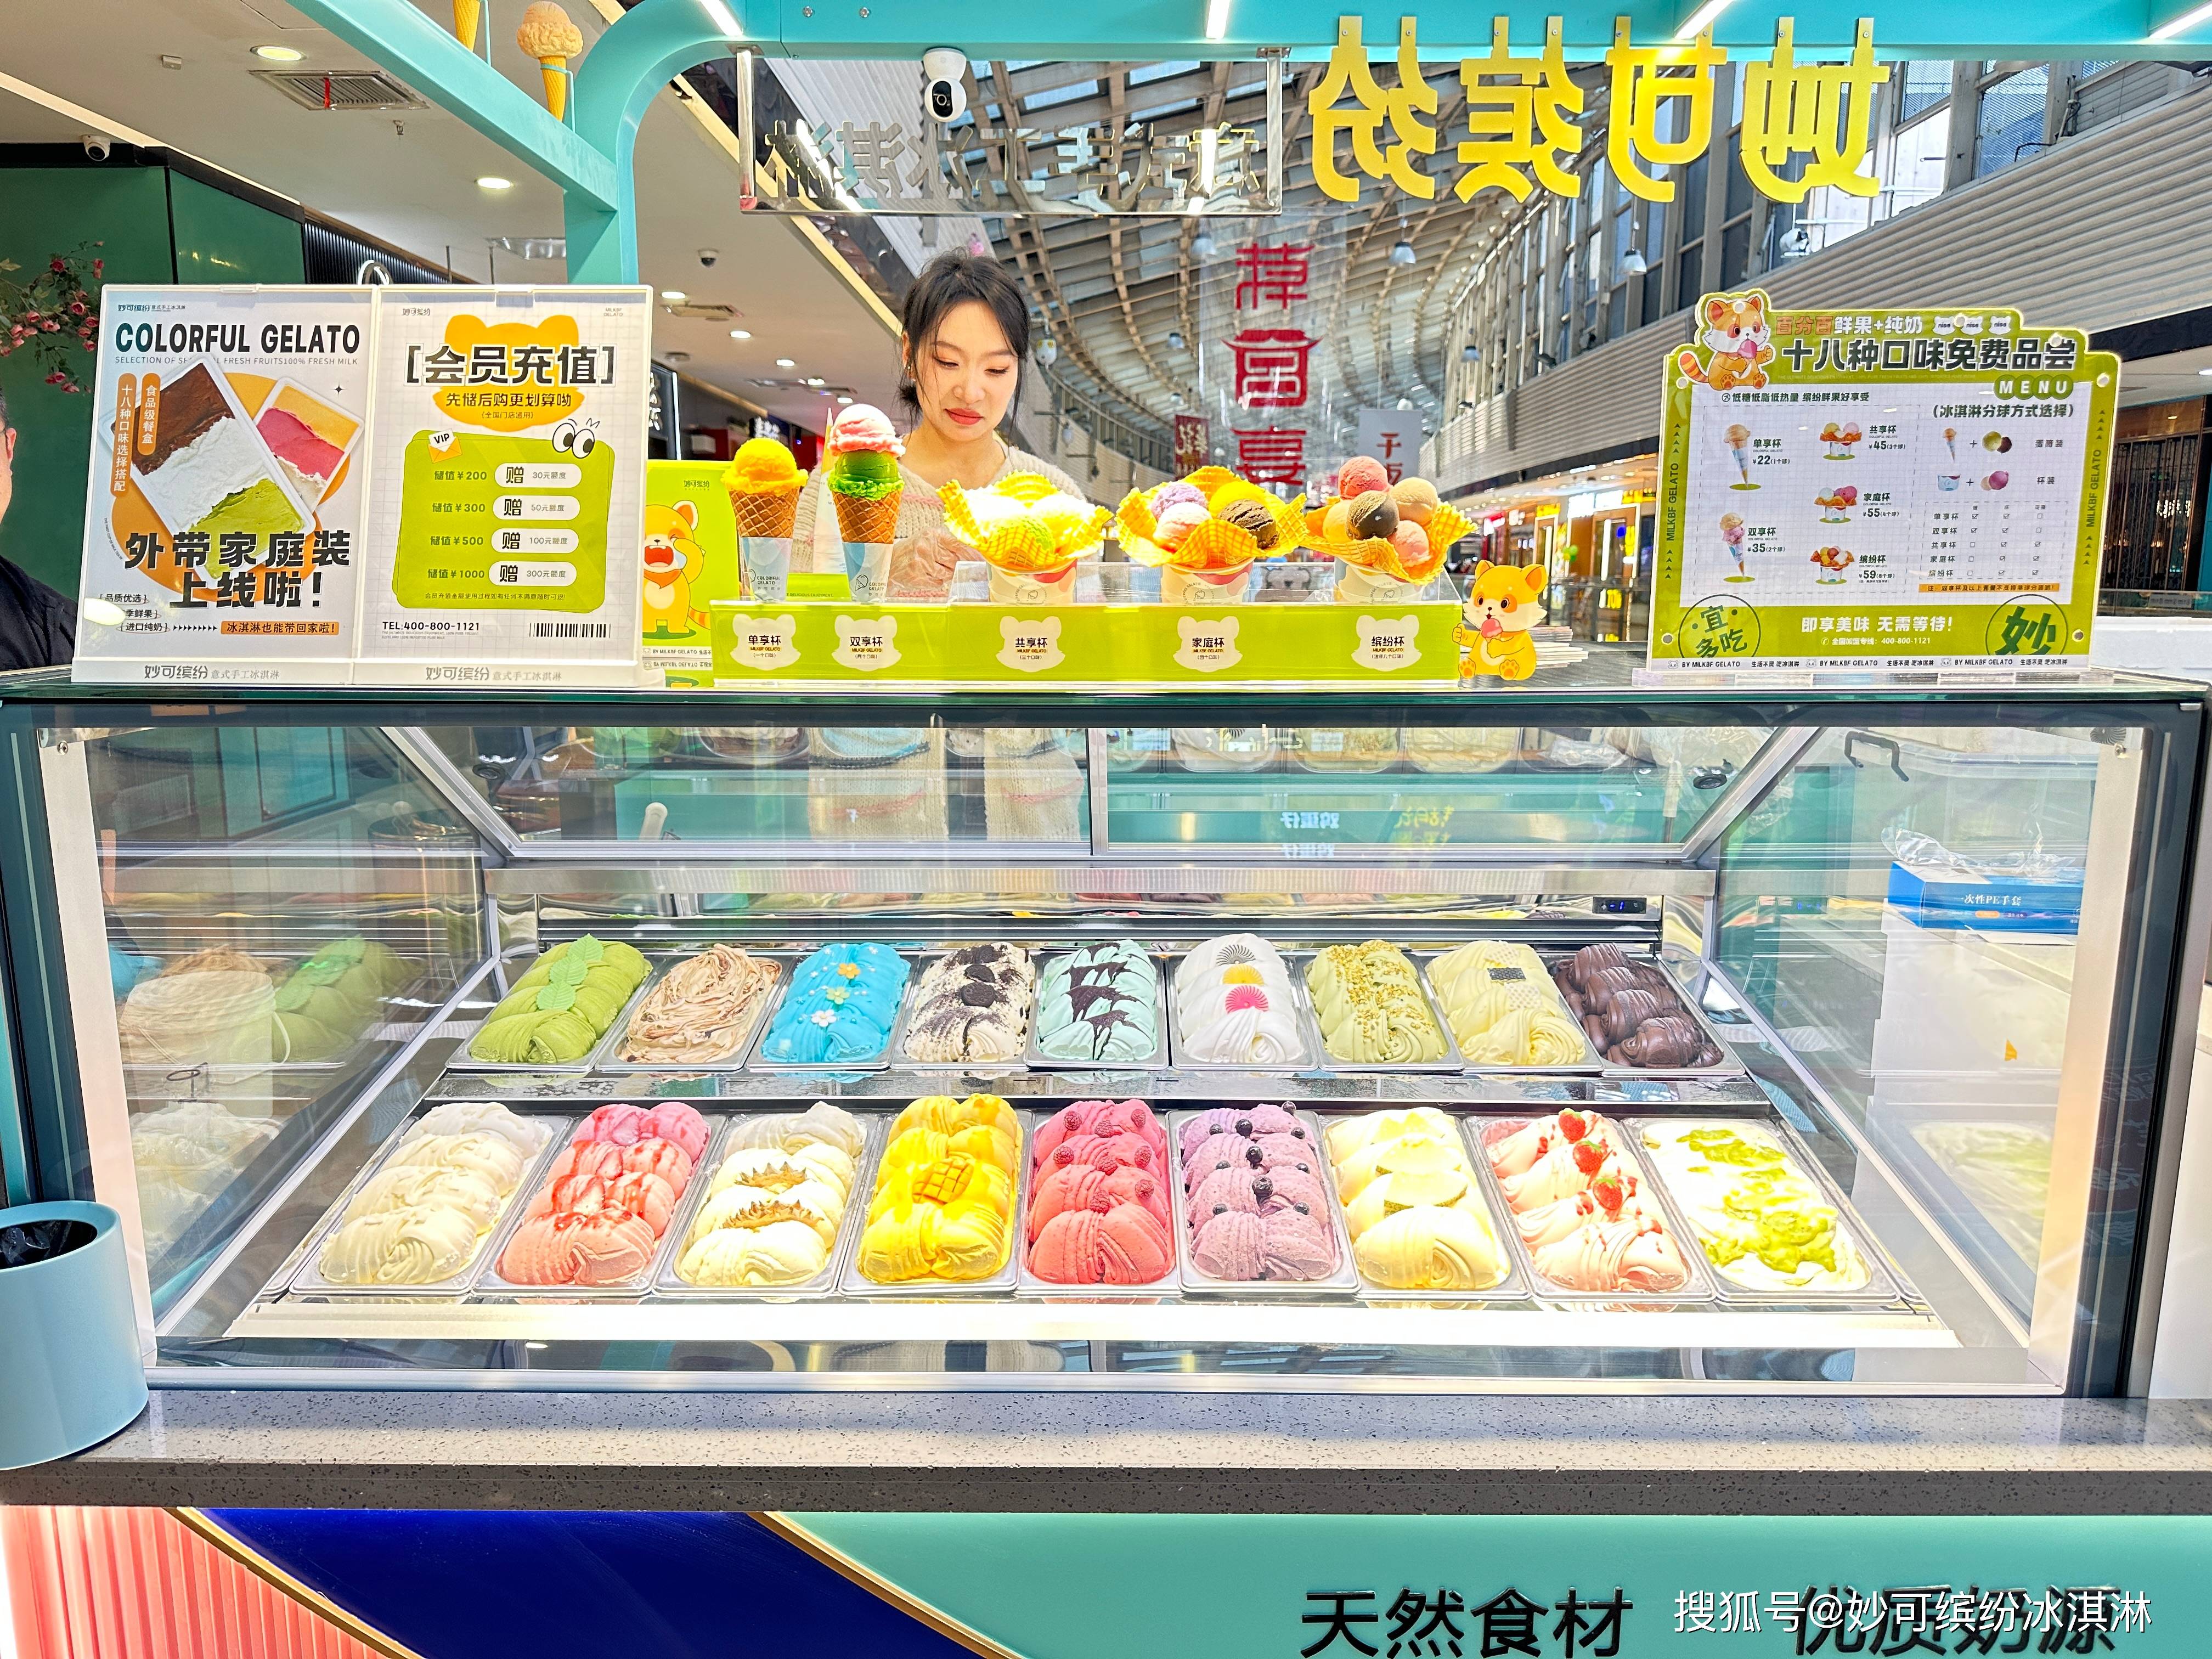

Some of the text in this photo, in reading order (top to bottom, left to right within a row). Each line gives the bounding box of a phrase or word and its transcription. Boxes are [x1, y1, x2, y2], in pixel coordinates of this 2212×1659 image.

[1776, 315, 1922, 335] 百分百鲜果+纯奶
[115, 323, 360, 354] COLORFUL GELATO
[1782, 338, 2076, 372] 十八种口味免费品尝
[1999, 381, 2067, 394] MENU
[1732, 392, 1870, 403] 低糖低脂低热量 缤纷鲜果好享受
[141, 384, 157, 445] 食品级餐盒
[1933, 404, 2074, 418] (冰淇淋分球方式选择)
[1869, 425, 1897, 434] 共享杯
[114, 384, 133, 492] 十八种口味选择搭配
[433, 433, 450, 444] VIP
[1753, 438, 1781, 448] 单享杯
[2035, 439, 2063, 448] 蛋筒装
[506, 466, 523, 484] 赠
[2087, 449, 2101, 527] MILKBF GELATO
[1667, 462, 1679, 541] MILKBF GELATO
[1863, 493, 1891, 502] 家庭杯
[504, 499, 522, 516] 赠
[1748, 527, 1776, 537] 双享杯
[502, 532, 521, 550] 赠
[529, 537, 568, 545] 100元额度
[125, 530, 352, 569] 外带家庭装
[1859, 555, 1887, 564] 缤纷杯
[499, 565, 518, 583] 赠
[526, 569, 566, 578] 300元额度
[169, 571, 321, 608] 上线啦!
[1700, 605, 1729, 633] 宜
[1801, 616, 1953, 633] 即享美味 无需等待!
[227, 622, 336, 634] 冰淇淋也能带回家啦!
[1994, 606, 2057, 656] 妙
[748, 635, 781, 646] 单享杯
[850, 636, 883, 646] 双享杯
[1015, 637, 1048, 648] 共享杯
[1192, 637, 1225, 648] 家庭杯
[1371, 636, 1405, 647] 缤纷杯
[1696, 628, 1747, 658] 多吃
[144, 664, 280, 680] 妙可缤纷 意式手工冰淇淋
[426, 667, 562, 681] 妙可缤纷 意式手工冰淇淋
[1960, 894, 2022, 906] 一次性PE手套
[1299, 1585, 1633, 1658] 天然食材
